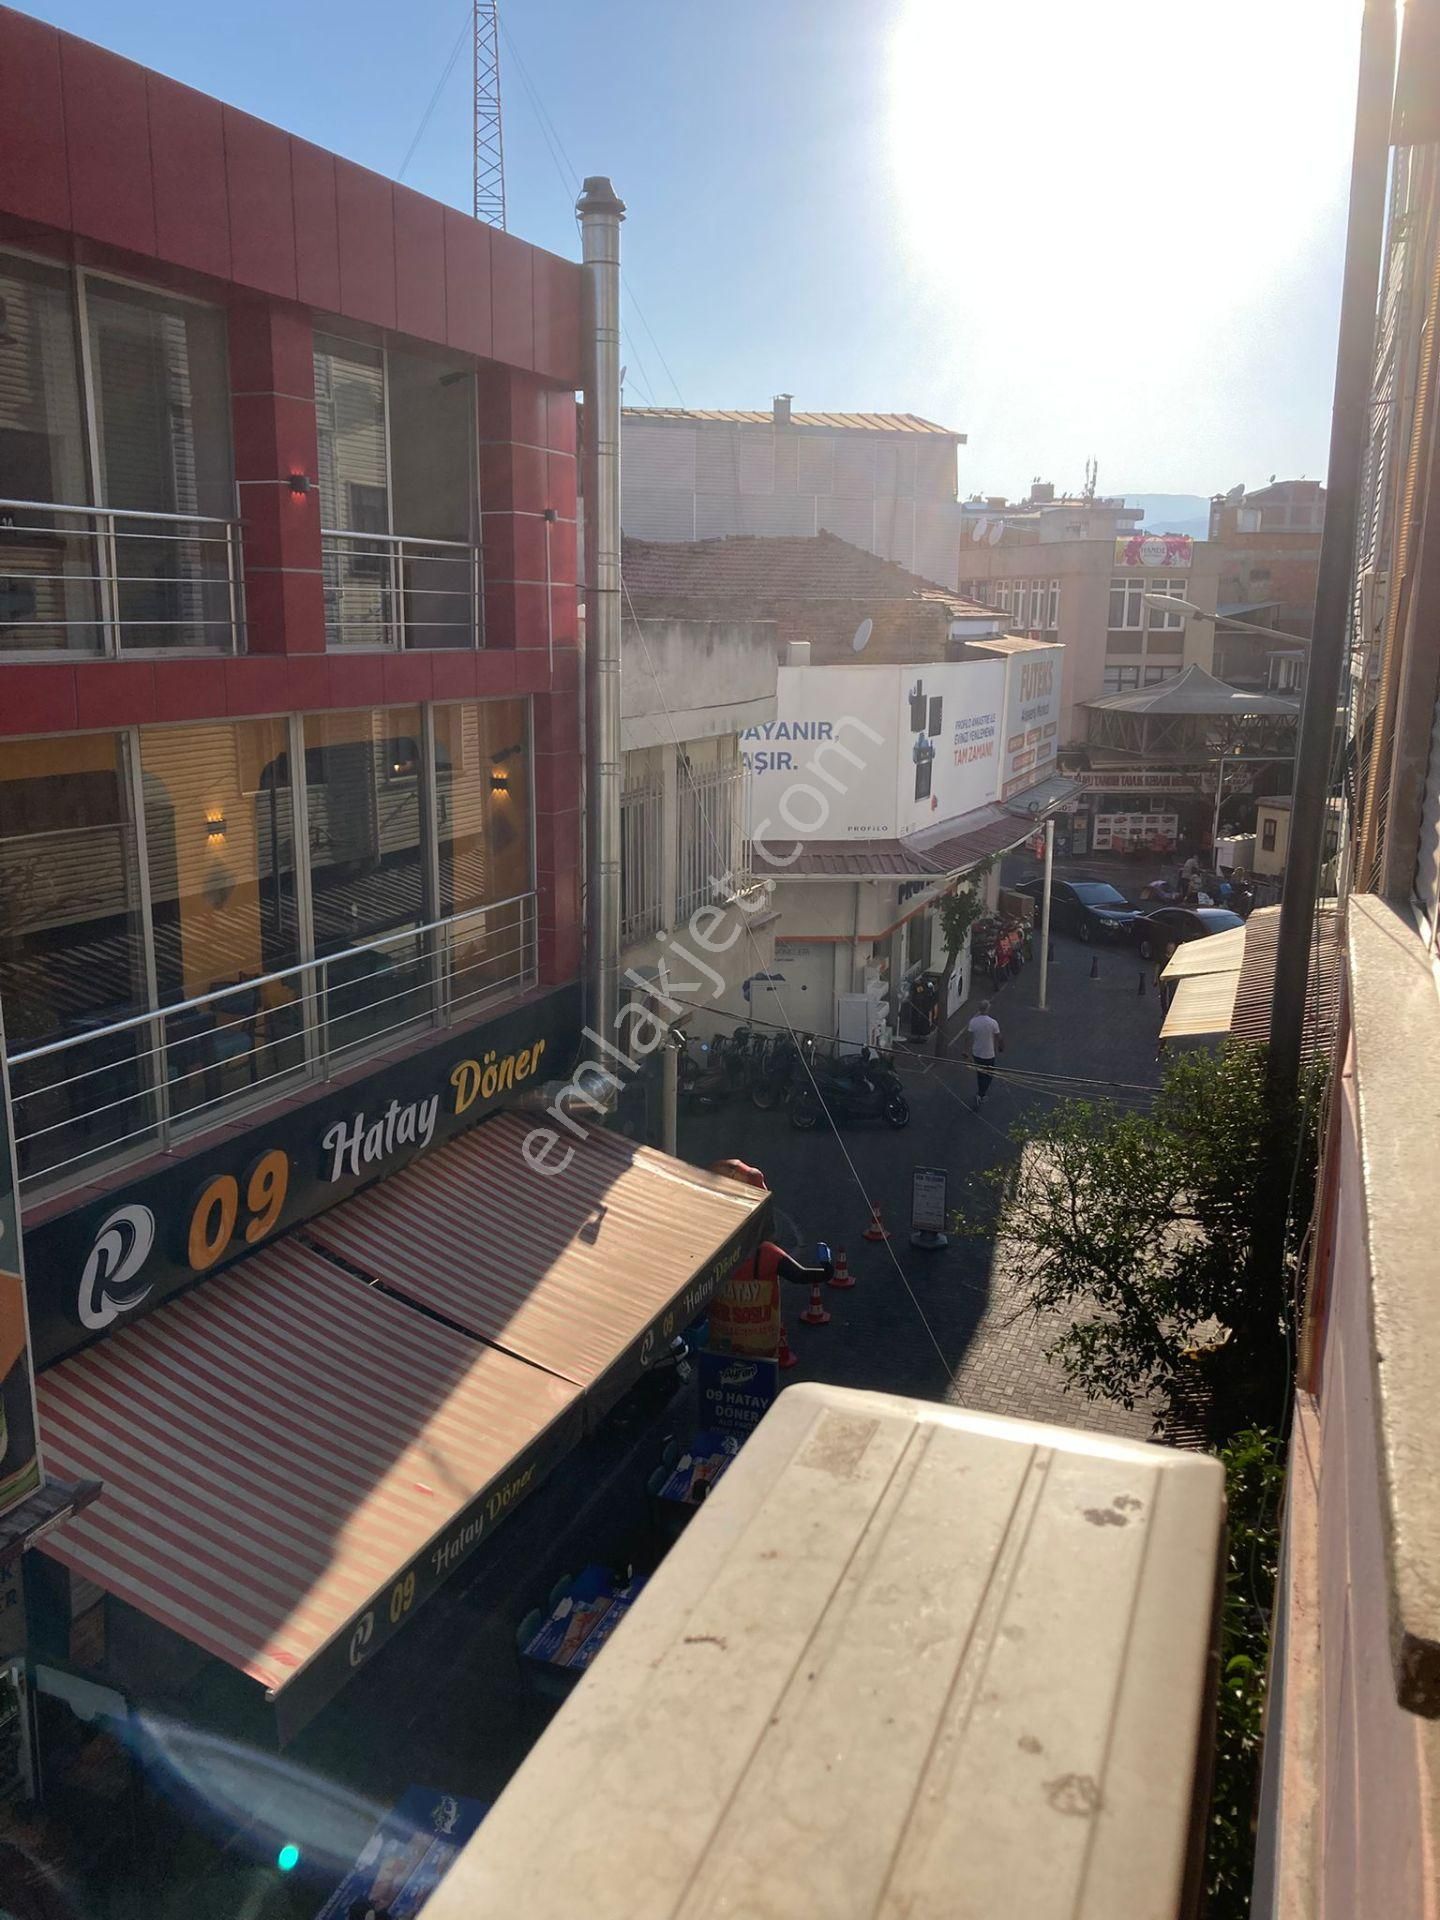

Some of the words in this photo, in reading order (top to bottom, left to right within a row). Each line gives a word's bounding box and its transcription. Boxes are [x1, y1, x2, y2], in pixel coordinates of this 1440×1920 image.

[186, 1149, 289, 1271] 09
[322, 1094, 440, 1183] Hatay
[450, 1038, 547, 1115] Döner
[683, 1276, 714, 1313] Hatay
[706, 1388, 723, 1401] 09
[726, 1392, 769, 1409] HATAY
[715, 1404, 760, 1423] DÖNER
[390, 1571, 415, 1624] 09
[431, 1514, 484, 1576] Hatay
[486, 1463, 536, 1521] Döner
